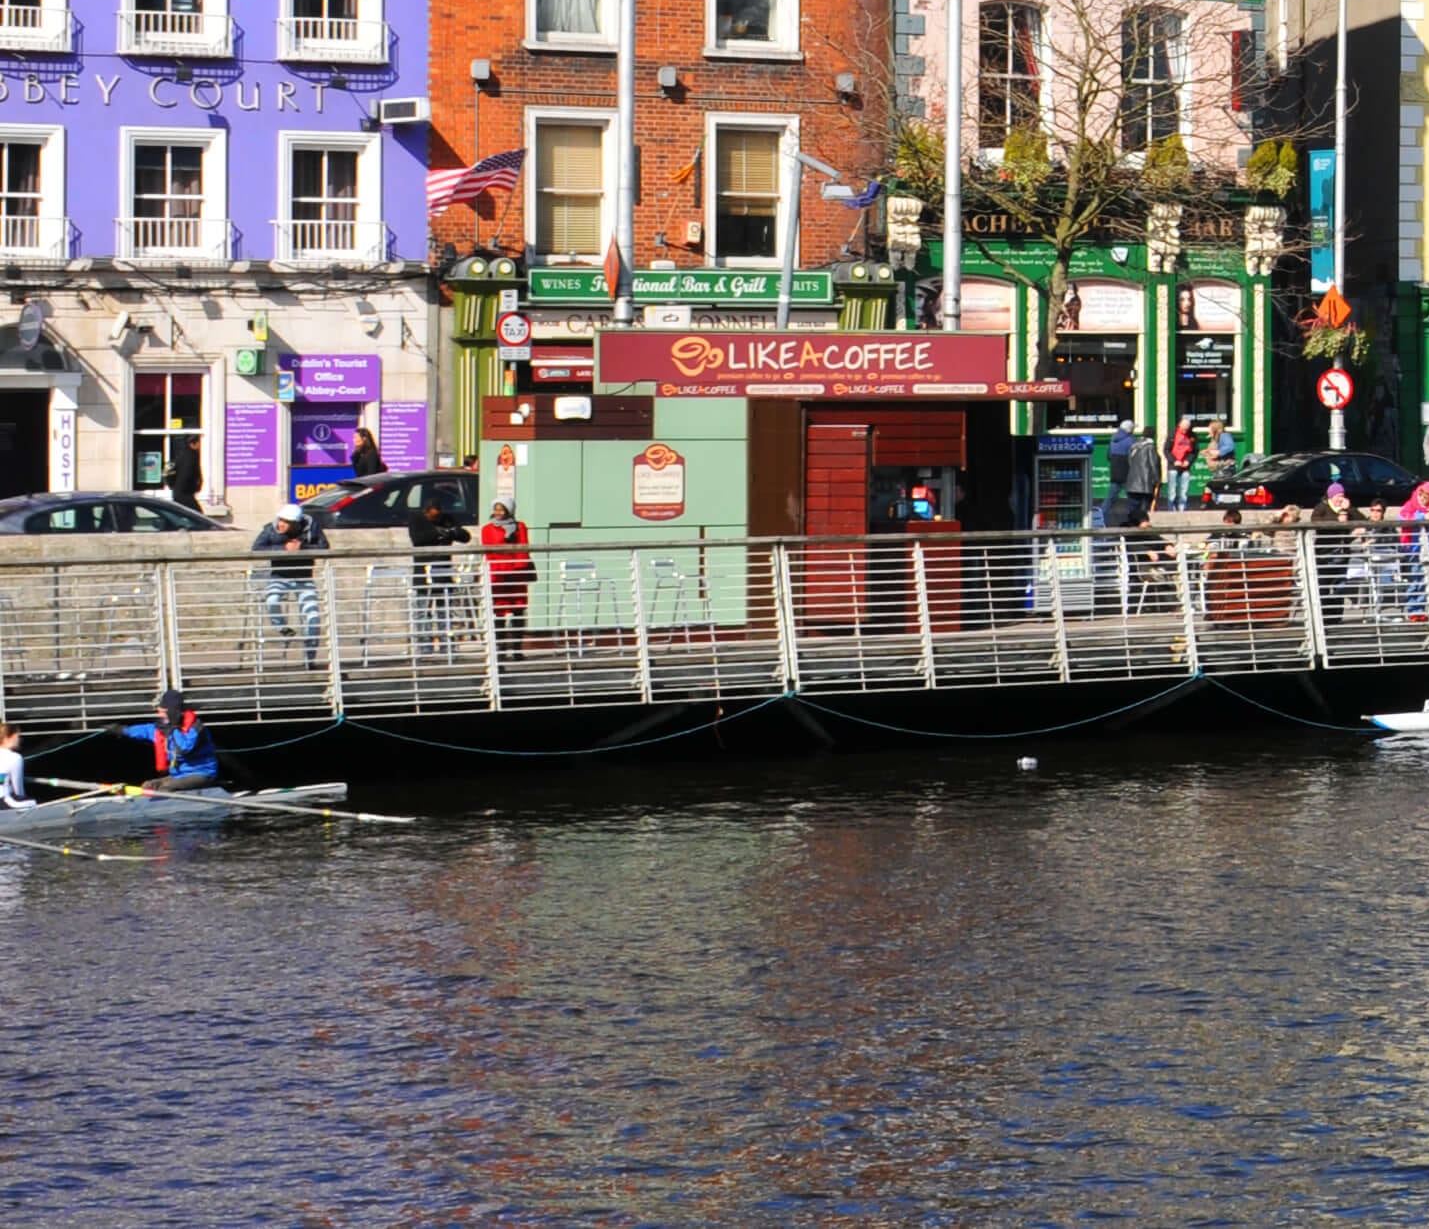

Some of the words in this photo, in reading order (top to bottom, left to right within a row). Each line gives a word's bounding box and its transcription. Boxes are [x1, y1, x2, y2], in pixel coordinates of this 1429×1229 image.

[150, 76, 329, 113] COURT
[541, 278, 582, 290] WINES
[590, 275, 677, 293] Trtional
[681, 275, 711, 293] Bar
[714, 277, 726, 292] &
[731, 276, 766, 294] Grill
[776, 280, 819, 291] SRITS
[504, 327, 526, 337] TAXI
[291, 358, 331, 368] Dublin's
[334, 358, 368, 368] Tourist
[314, 372, 345, 382] Office
[61, 415, 71, 488] HOST
